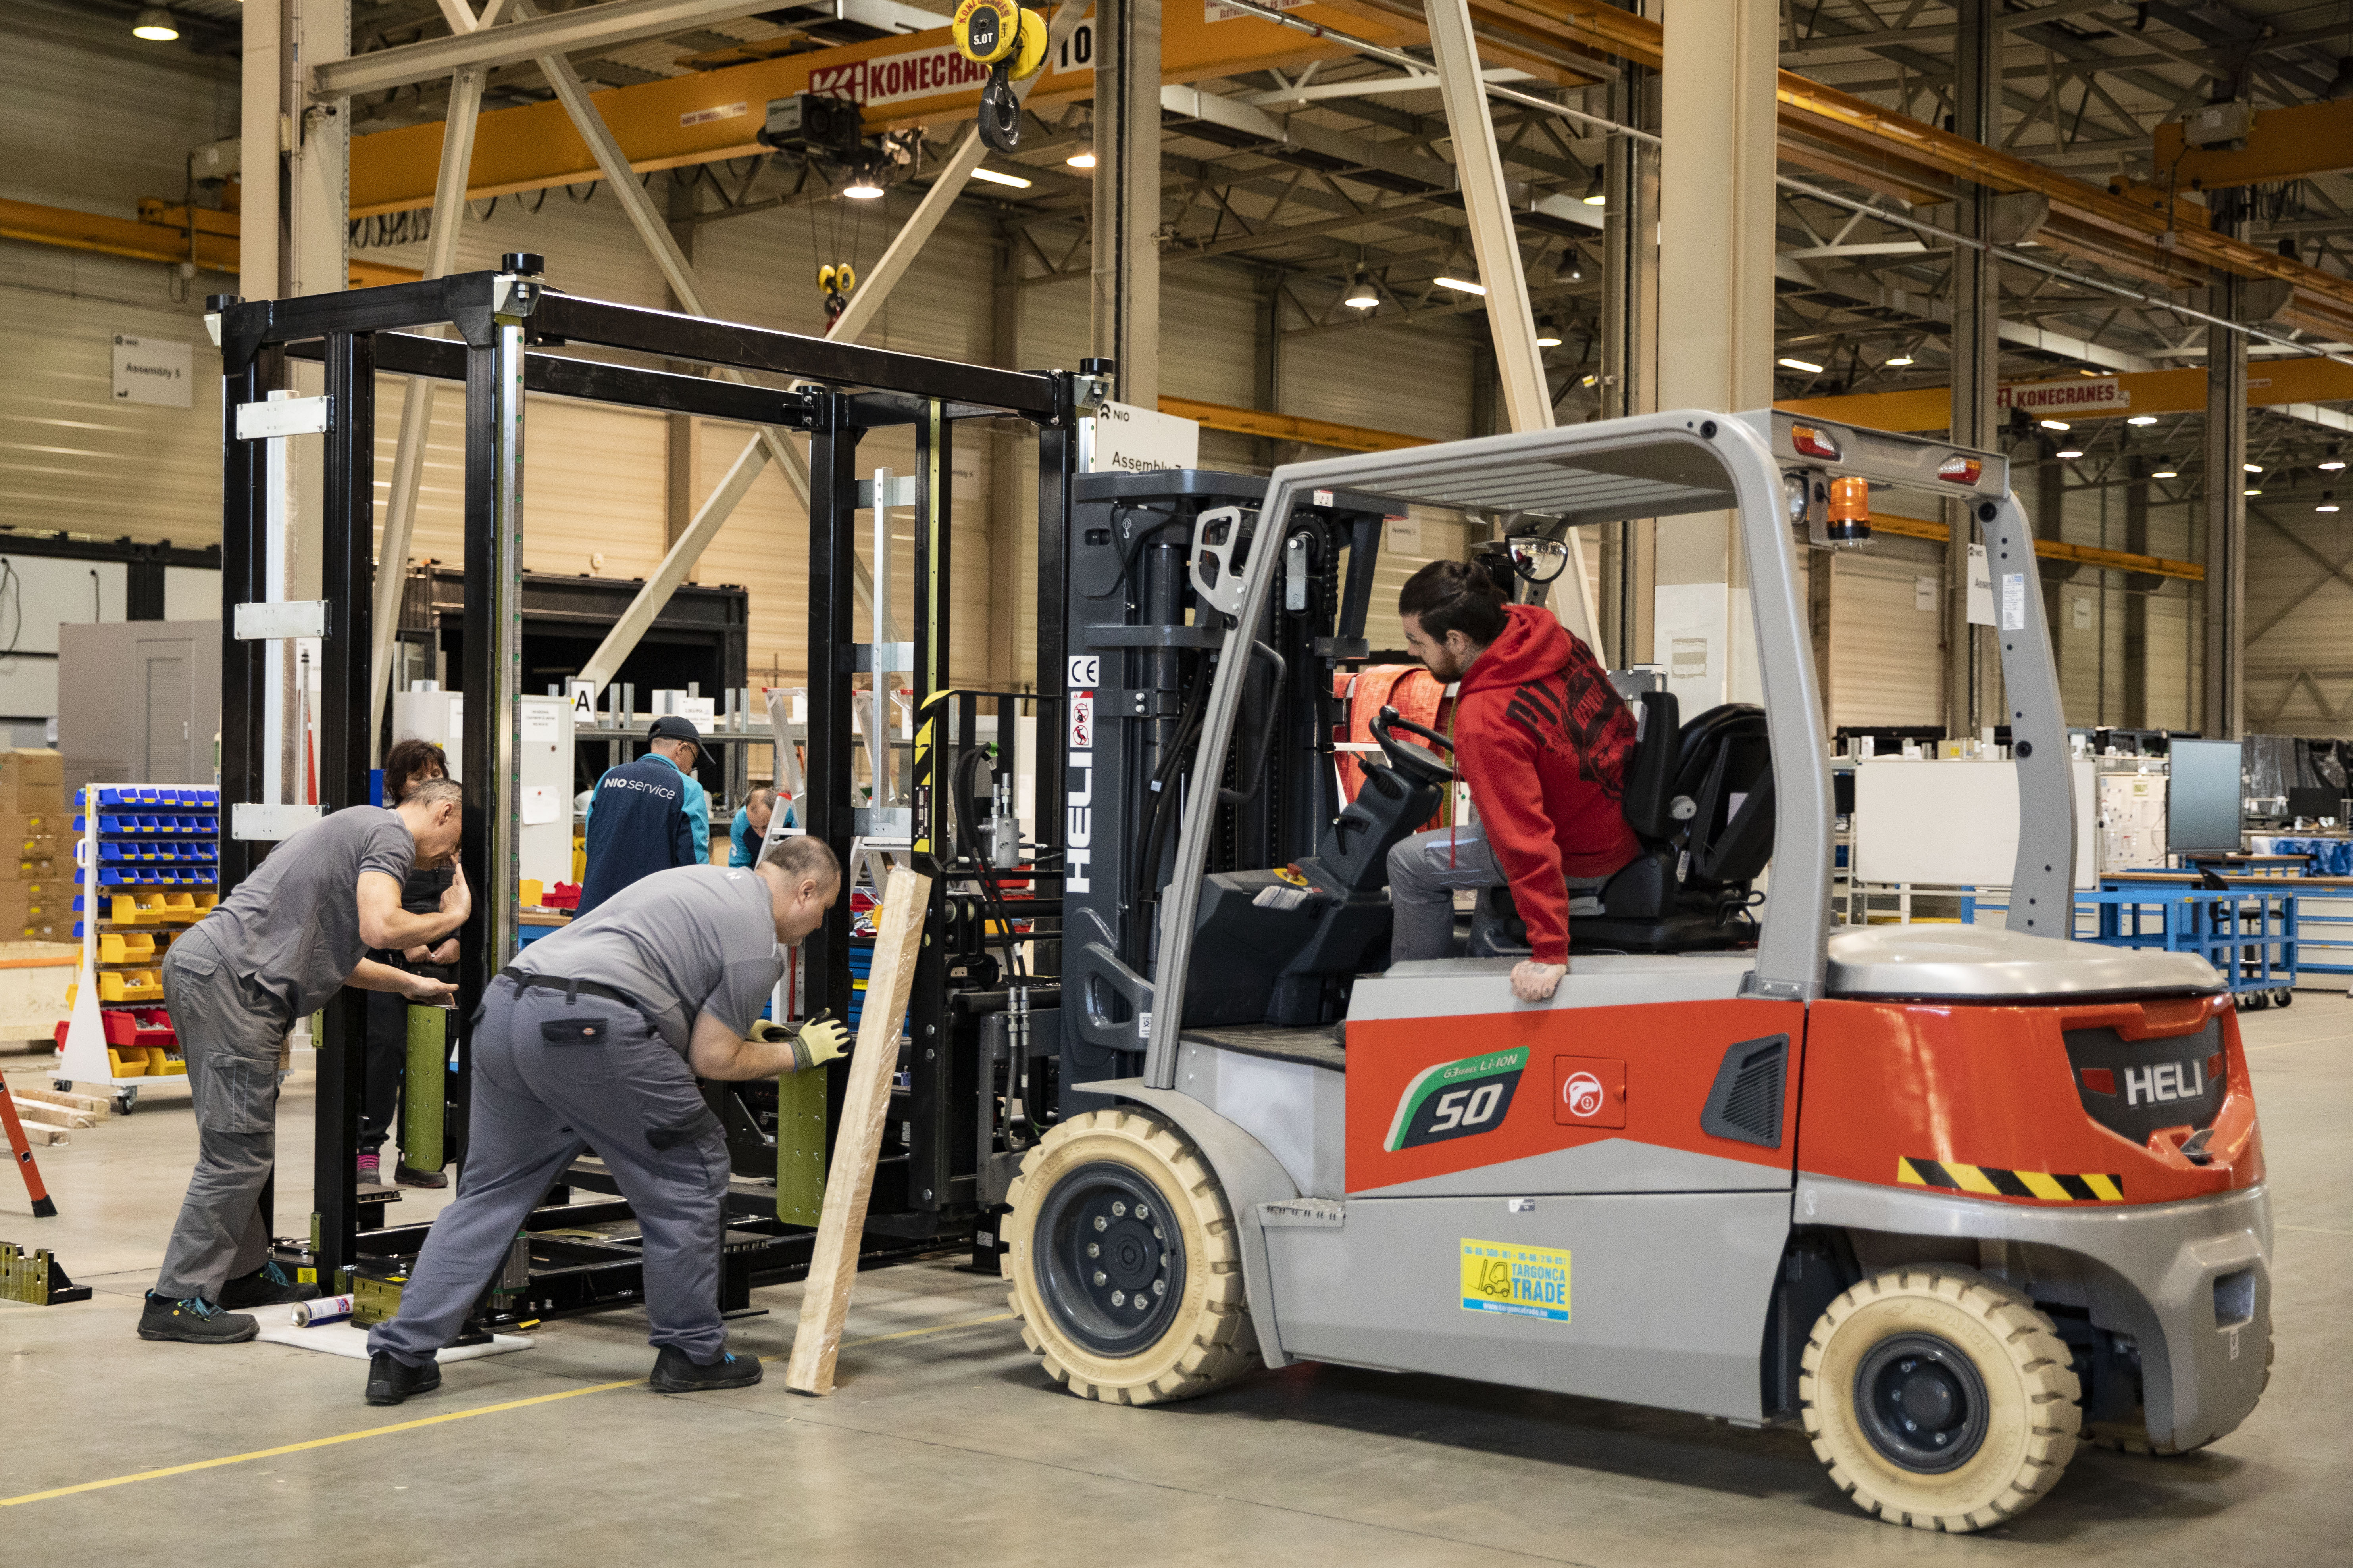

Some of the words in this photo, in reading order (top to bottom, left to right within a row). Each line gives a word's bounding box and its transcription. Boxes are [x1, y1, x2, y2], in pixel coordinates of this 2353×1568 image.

[973, 33, 993, 45] 5.0T
[1061, 25, 1091, 68] 10
[2017, 384, 2115, 409] KONECRANES
[1114, 410, 1130, 422] NIO
[1072, 660, 1096, 683] CE
[575, 690, 591, 712] A
[604, 778, 627, 788] NIO
[627, 780, 675, 799] service
[1066, 752, 1093, 893] HELI
[1480, 1053, 1518, 1072] Li-ION
[2124, 1059, 2203, 1105] HELI
[1428, 1083, 1504, 1133] 50
[1511, 1263, 1566, 1282] TARGONCA
[1511, 1277, 1566, 1305] TRADE
